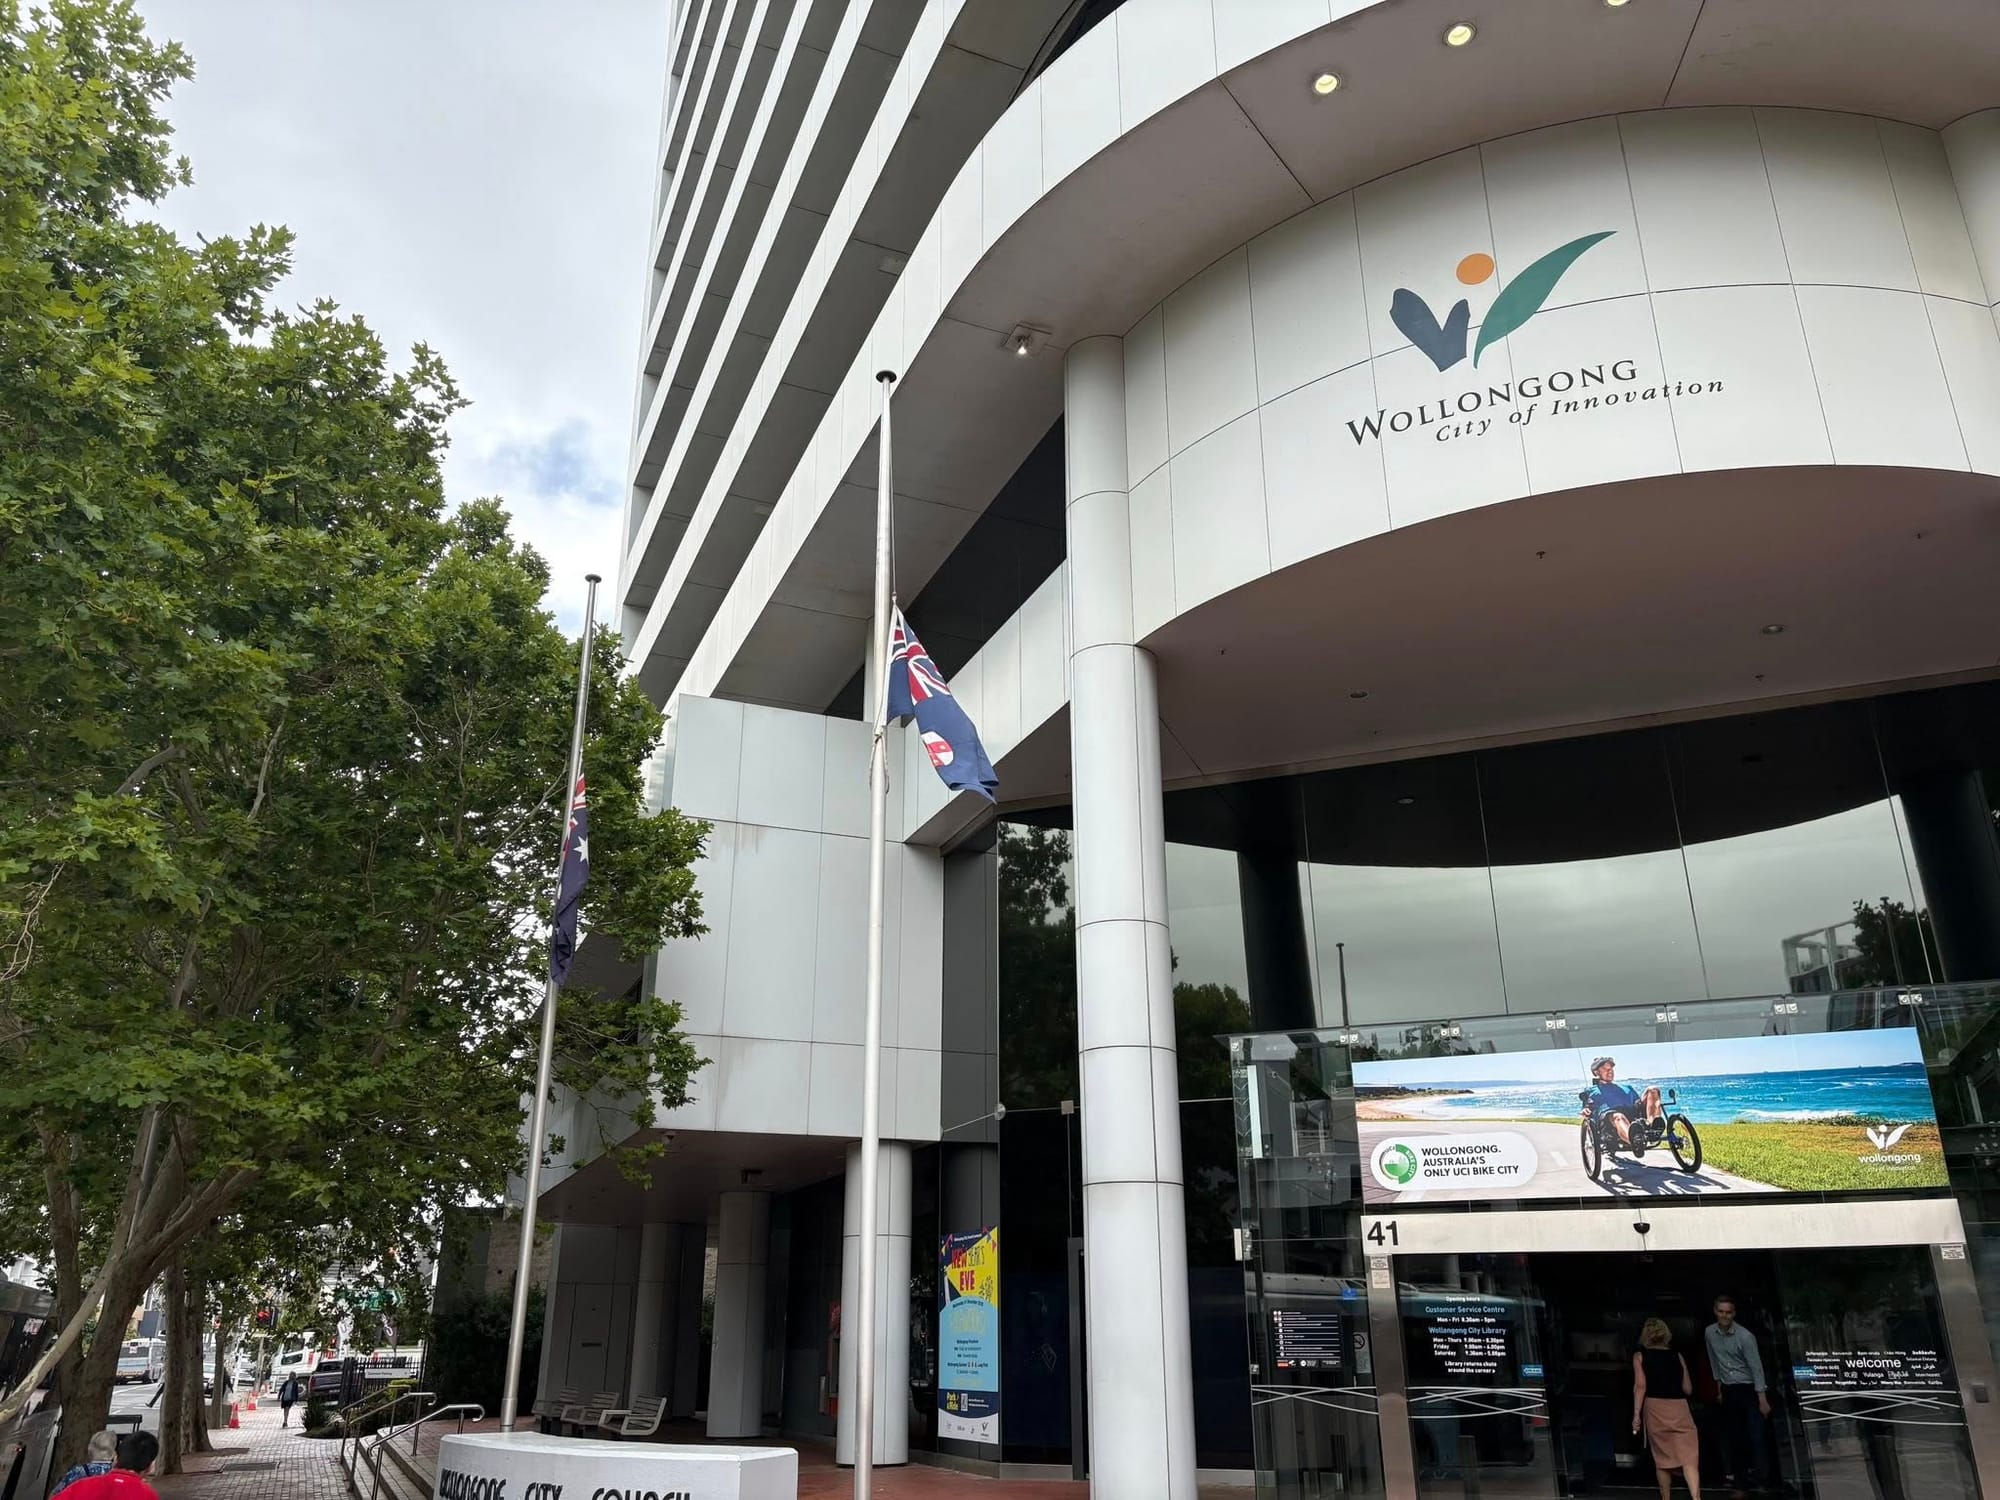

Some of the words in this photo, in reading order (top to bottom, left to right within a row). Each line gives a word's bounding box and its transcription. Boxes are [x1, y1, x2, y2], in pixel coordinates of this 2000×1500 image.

[1345, 359, 1638, 446] WOLLONGONG
[1436, 417, 1491, 442] City
[1509, 403, 1538, 426] of
[1552, 379, 1724, 416] Innovation
[1421, 1145, 1502, 1156] WOLLONGONG.
[1423, 1156, 1486, 1167] AUSTRALIA'S
[1858, 1153, 1921, 1164] wollongong
[1423, 1168, 1450, 1178] ONLY
[1453, 1167, 1470, 1177] UCI
[1473, 1166, 1494, 1176] BIKE
[1498, 1165, 1520, 1176] CITY
[1367, 1220, 1399, 1246] 41
[959, 1270, 975, 1291] EVE
[1428, 1327, 1467, 1335] Wollongong
[1481, 1327, 1506, 1335] Library
[1845, 1357, 1901, 1368] welcome
